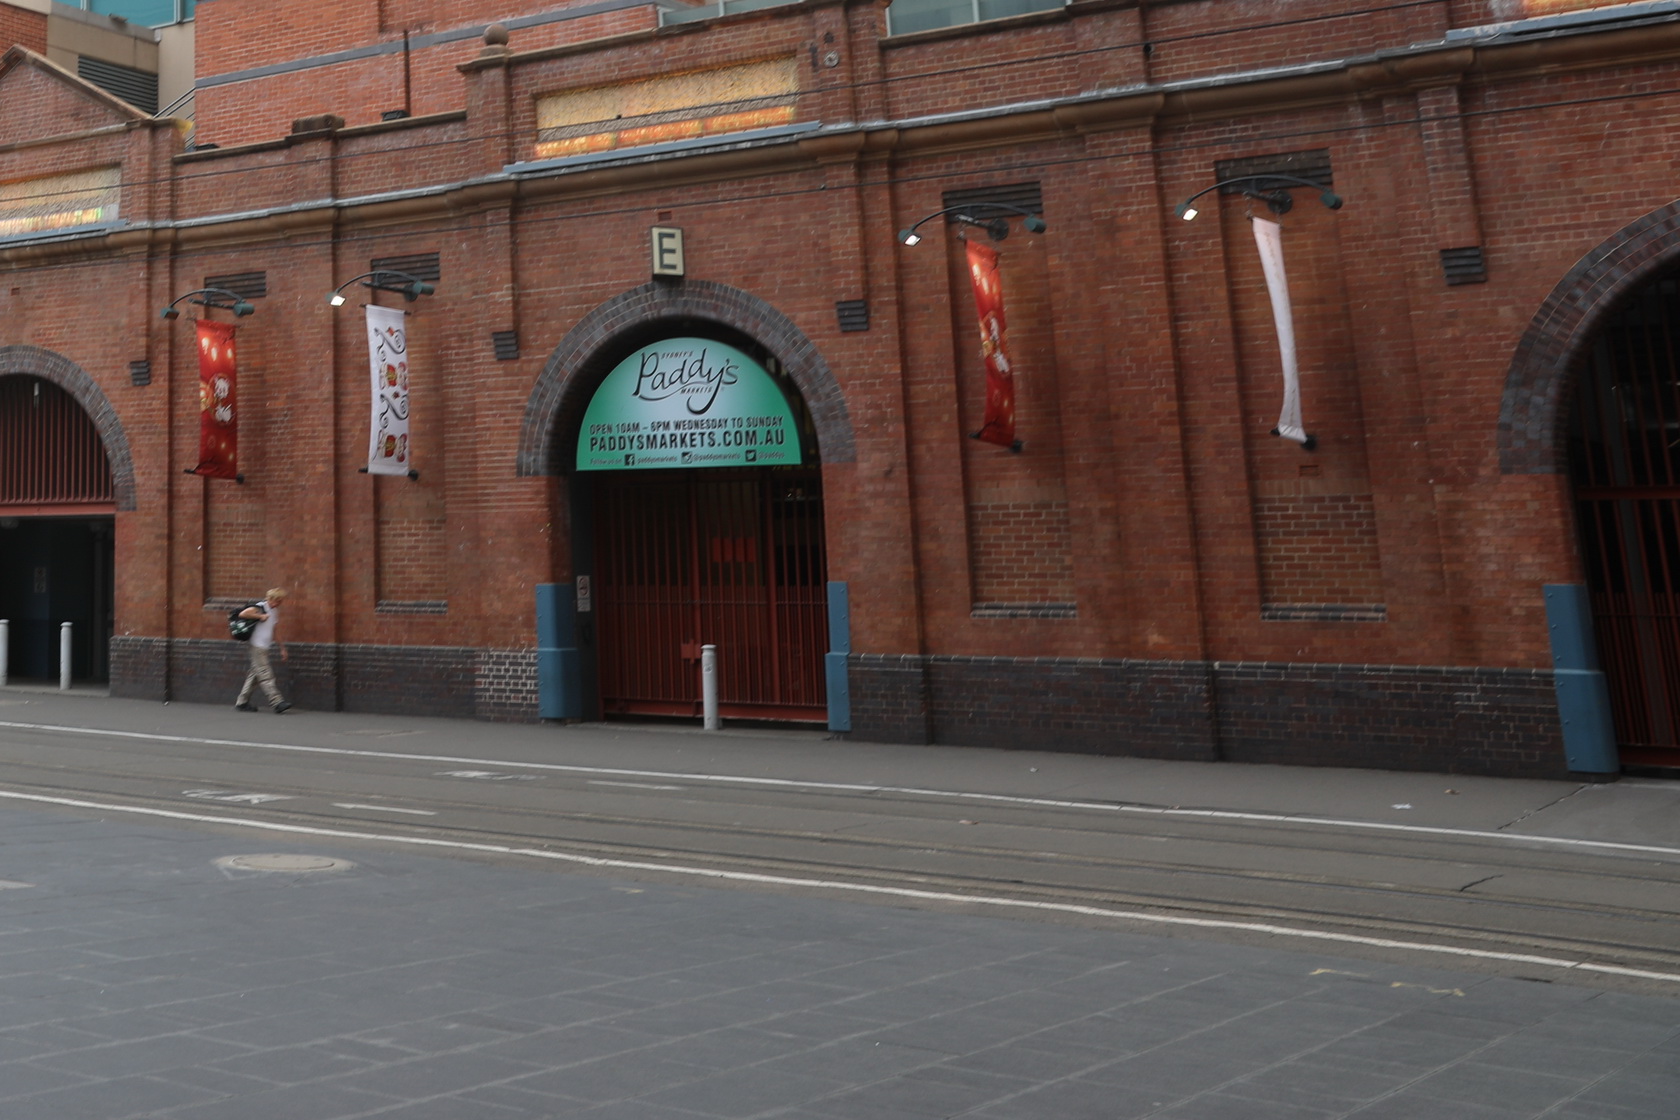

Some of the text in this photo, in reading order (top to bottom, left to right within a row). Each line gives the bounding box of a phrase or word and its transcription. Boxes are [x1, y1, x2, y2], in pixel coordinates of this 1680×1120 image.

[658, 232, 678, 270] E
[631, 347, 740, 415] Paddy's
[680, 386, 712, 395] MARKETS
[589, 422, 613, 435] OPEN
[616, 421, 640, 434] 10AM
[673, 417, 727, 431] WEDNESDAY
[731, 417, 743, 429] TO
[746, 415, 783, 428] SUNDAY
[589, 430, 785, 453] PADDYSMARKETS.COM.AU
